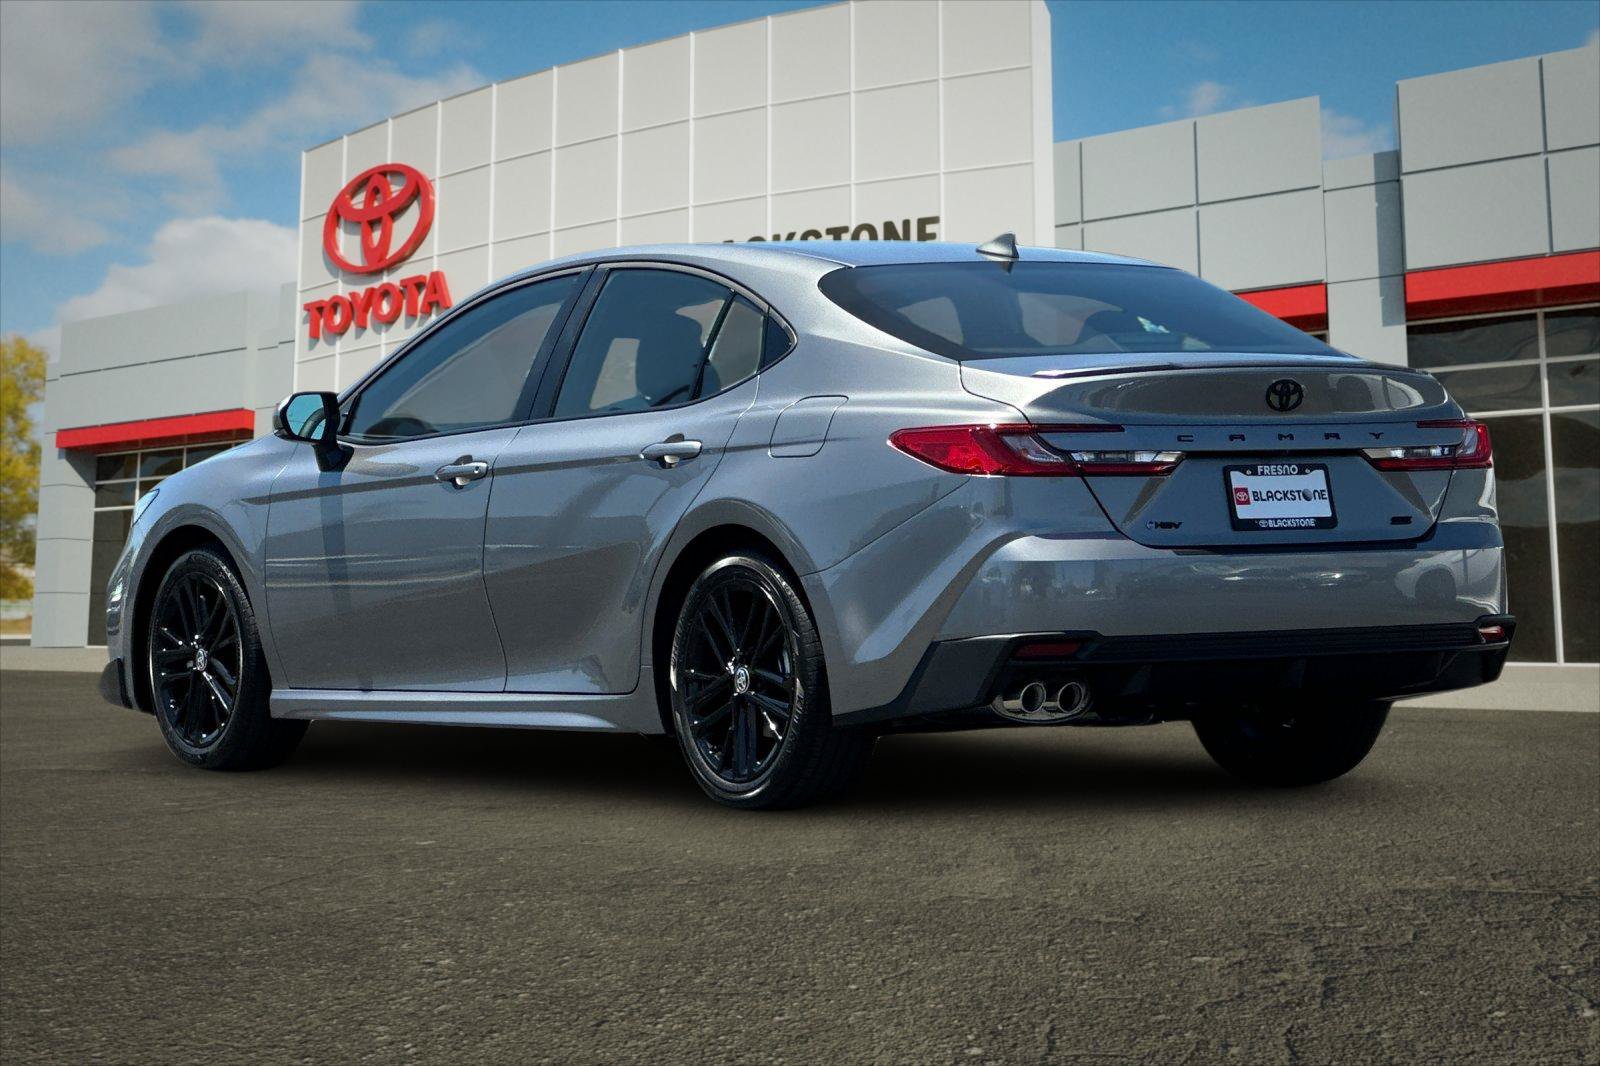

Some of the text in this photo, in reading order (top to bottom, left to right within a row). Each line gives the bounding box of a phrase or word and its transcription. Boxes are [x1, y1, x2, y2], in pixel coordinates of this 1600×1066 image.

[303, 271, 453, 339] TOYOTA
[1176, 432, 1384, 443] CAMRY
[1257, 465, 1298, 475] FRESNO
[1252, 489, 1328, 502] BLACKSTONE
[1268, 519, 1316, 528] BLACKSTONE
